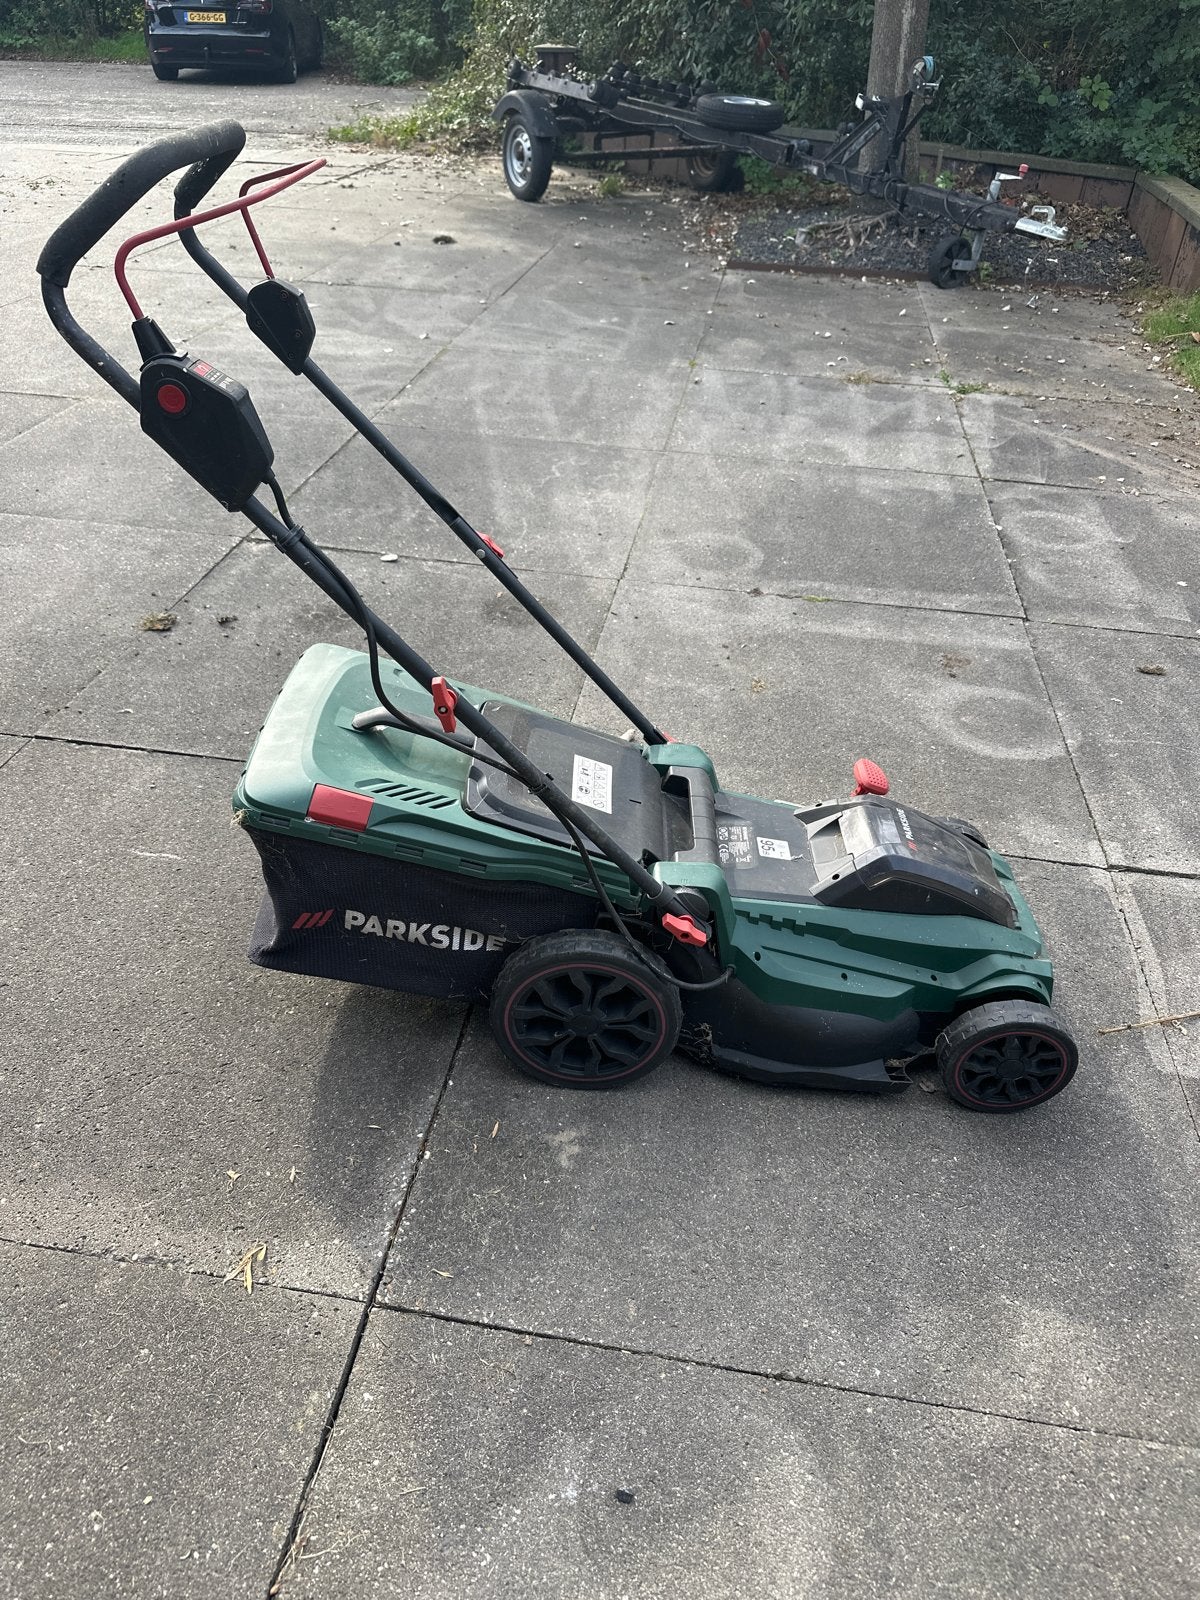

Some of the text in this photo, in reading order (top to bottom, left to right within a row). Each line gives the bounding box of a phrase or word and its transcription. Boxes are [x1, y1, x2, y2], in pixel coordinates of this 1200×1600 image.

[189, 13, 224, 22] G-366-GG
[760, 839, 775, 852] 95
[344, 909, 506, 951] PARKSIDE
